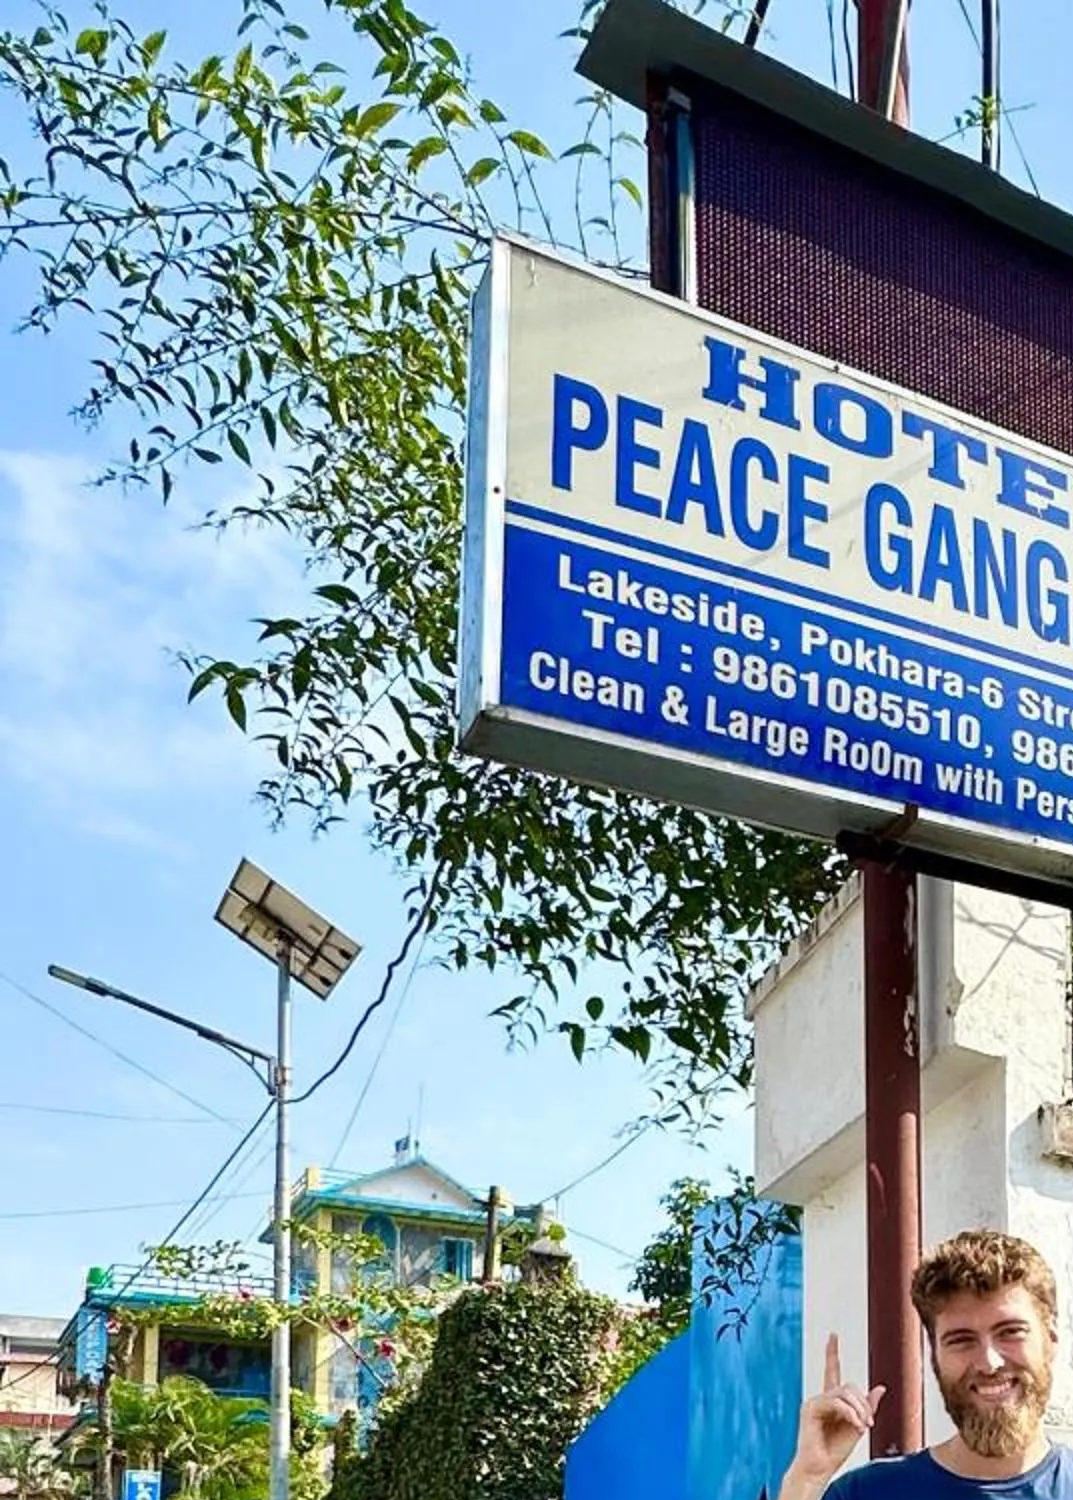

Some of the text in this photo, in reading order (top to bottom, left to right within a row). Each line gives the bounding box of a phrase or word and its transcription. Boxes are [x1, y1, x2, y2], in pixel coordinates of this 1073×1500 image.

[550, 373, 832, 568] PEACE
[558, 553, 781, 651] Lakeside,
[800, 621, 1004, 710] Pokhara-6
[581, 609, 660, 664] Tel
[681, 643, 693, 673] :
[712, 646, 994, 758] 9861085510,
[528, 650, 645, 715] Clean
[661, 684, 689, 726] &
[706, 694, 809, 757] Large
[935, 762, 1004, 805] with
